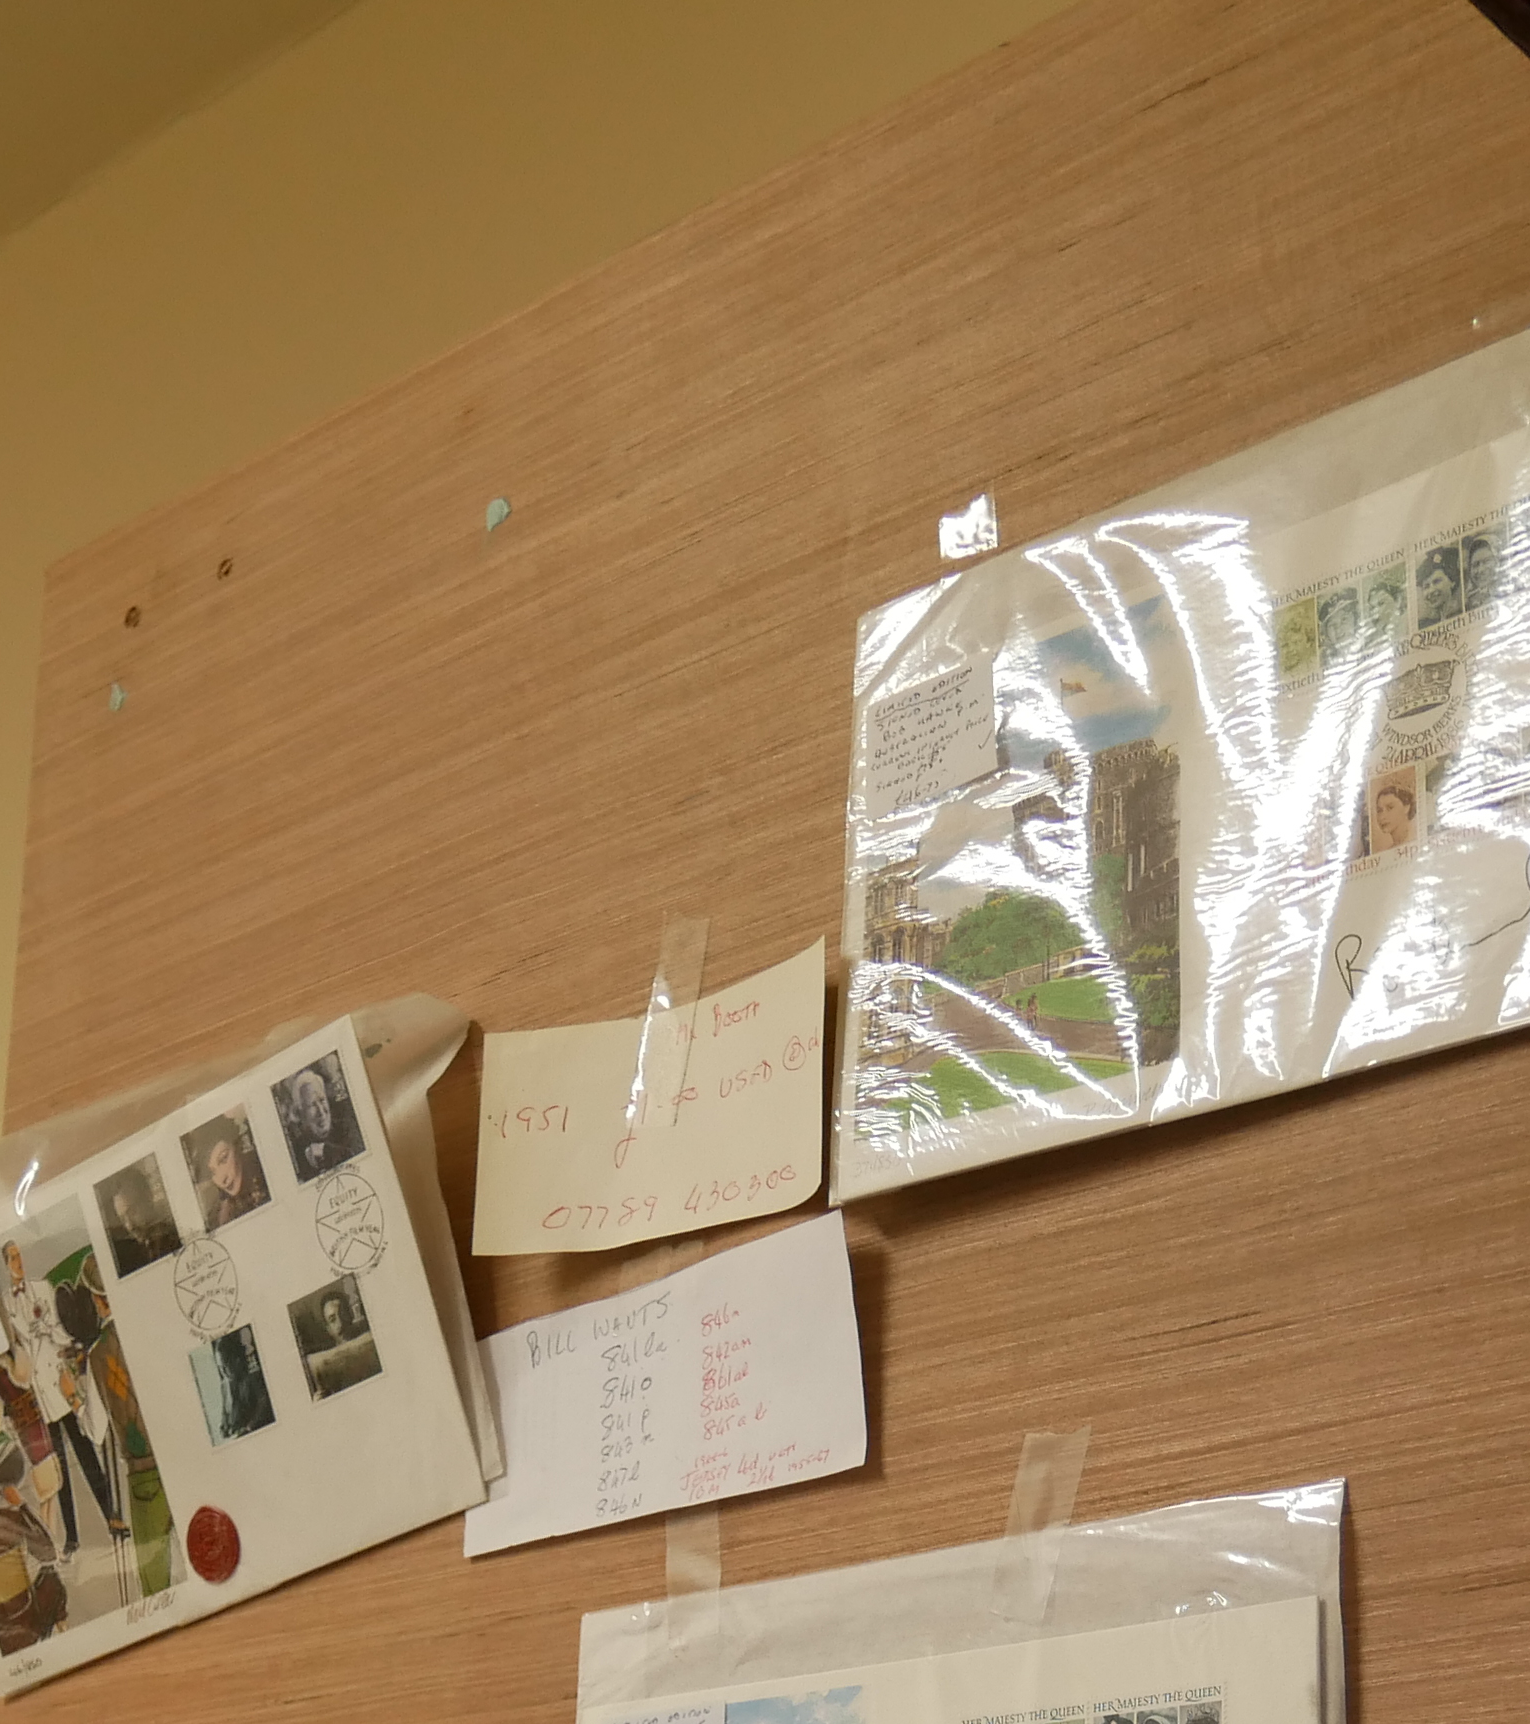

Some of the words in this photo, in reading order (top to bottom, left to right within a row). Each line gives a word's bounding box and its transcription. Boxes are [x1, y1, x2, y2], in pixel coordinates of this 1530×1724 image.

[1437, 514, 1487, 542] MAJESTY
[1295, 576, 1340, 597] MAJESTY
[1345, 566, 1364, 579] THE
[1365, 550, 1405, 573] QUEEN
[1028, 1708, 1048, 1721] THE
[1050, 1705, 1085, 1721] QUEEN
[1093, 1701, 1117, 1713] HER
[1116, 1693, 1160, 1711] MAJESTY
[1162, 1691, 1184, 1704] THE
[1185, 1685, 1221, 1702] QUEEN
